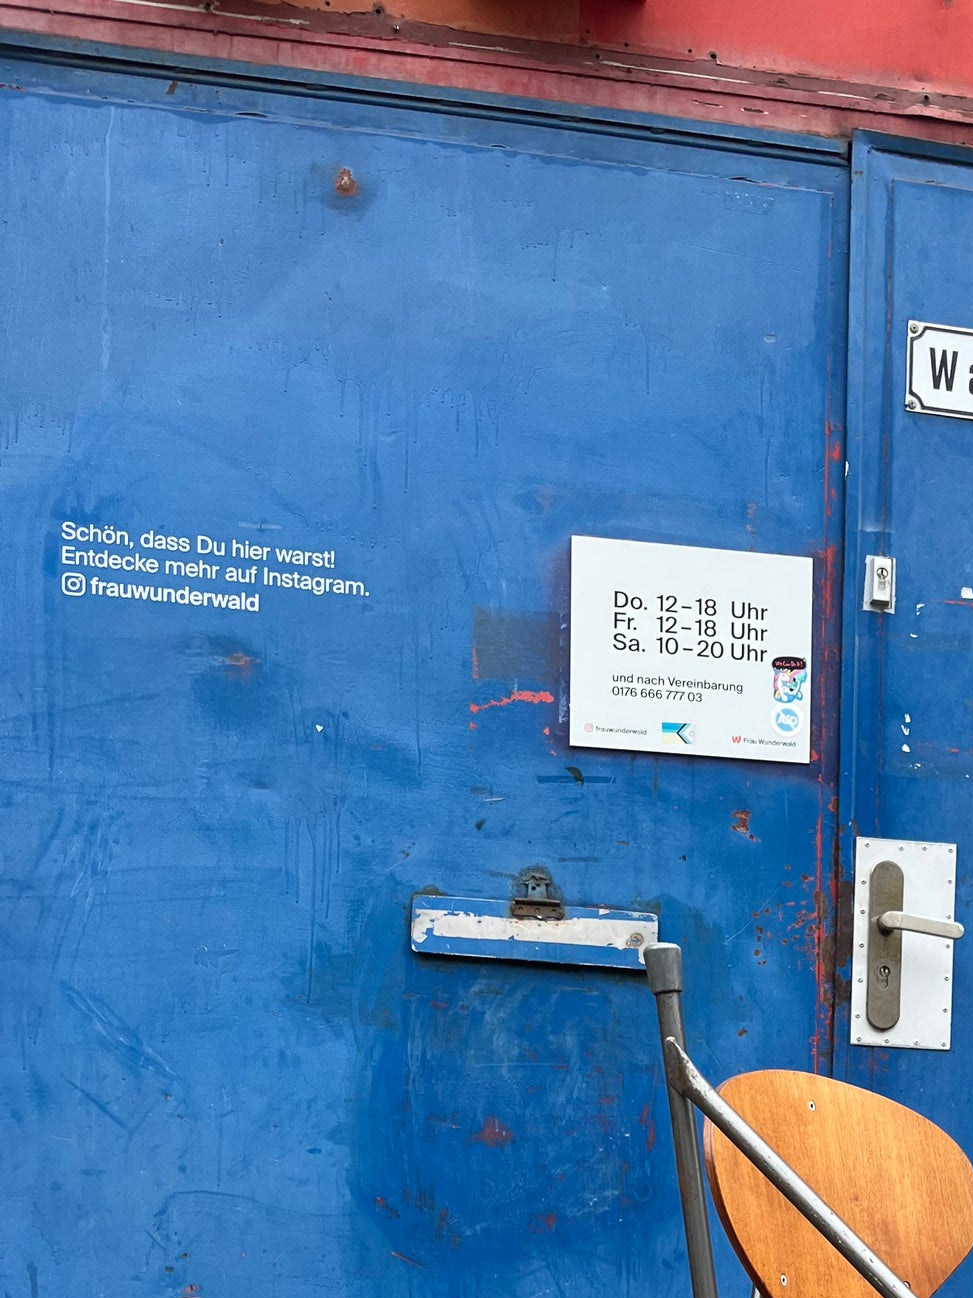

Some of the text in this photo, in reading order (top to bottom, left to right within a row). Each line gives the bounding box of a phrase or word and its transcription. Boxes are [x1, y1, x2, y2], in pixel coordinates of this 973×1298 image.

[61, 521, 335, 568] Schön, dass Du hier warst!
[62, 545, 370, 596] Entdecke mehr auf Instagram.
[90, 577, 259, 612] frauwunderwald
[614, 590, 648, 610] Do.
[731, 601, 768, 621] Uhr
[614, 611, 637, 630] Fr.
[731, 622, 768, 641] Uhr
[613, 633, 645, 652] Sa.
[731, 643, 767, 662] Uhr
[612, 674, 743, 694] und nach Vereinbarung
[612, 686, 703, 703] 0176 666 777 03
[595, 725, 647, 736] frauwunderwald
[744, 738, 757, 746] Frau
[758, 739, 797, 748] Wunderwald
